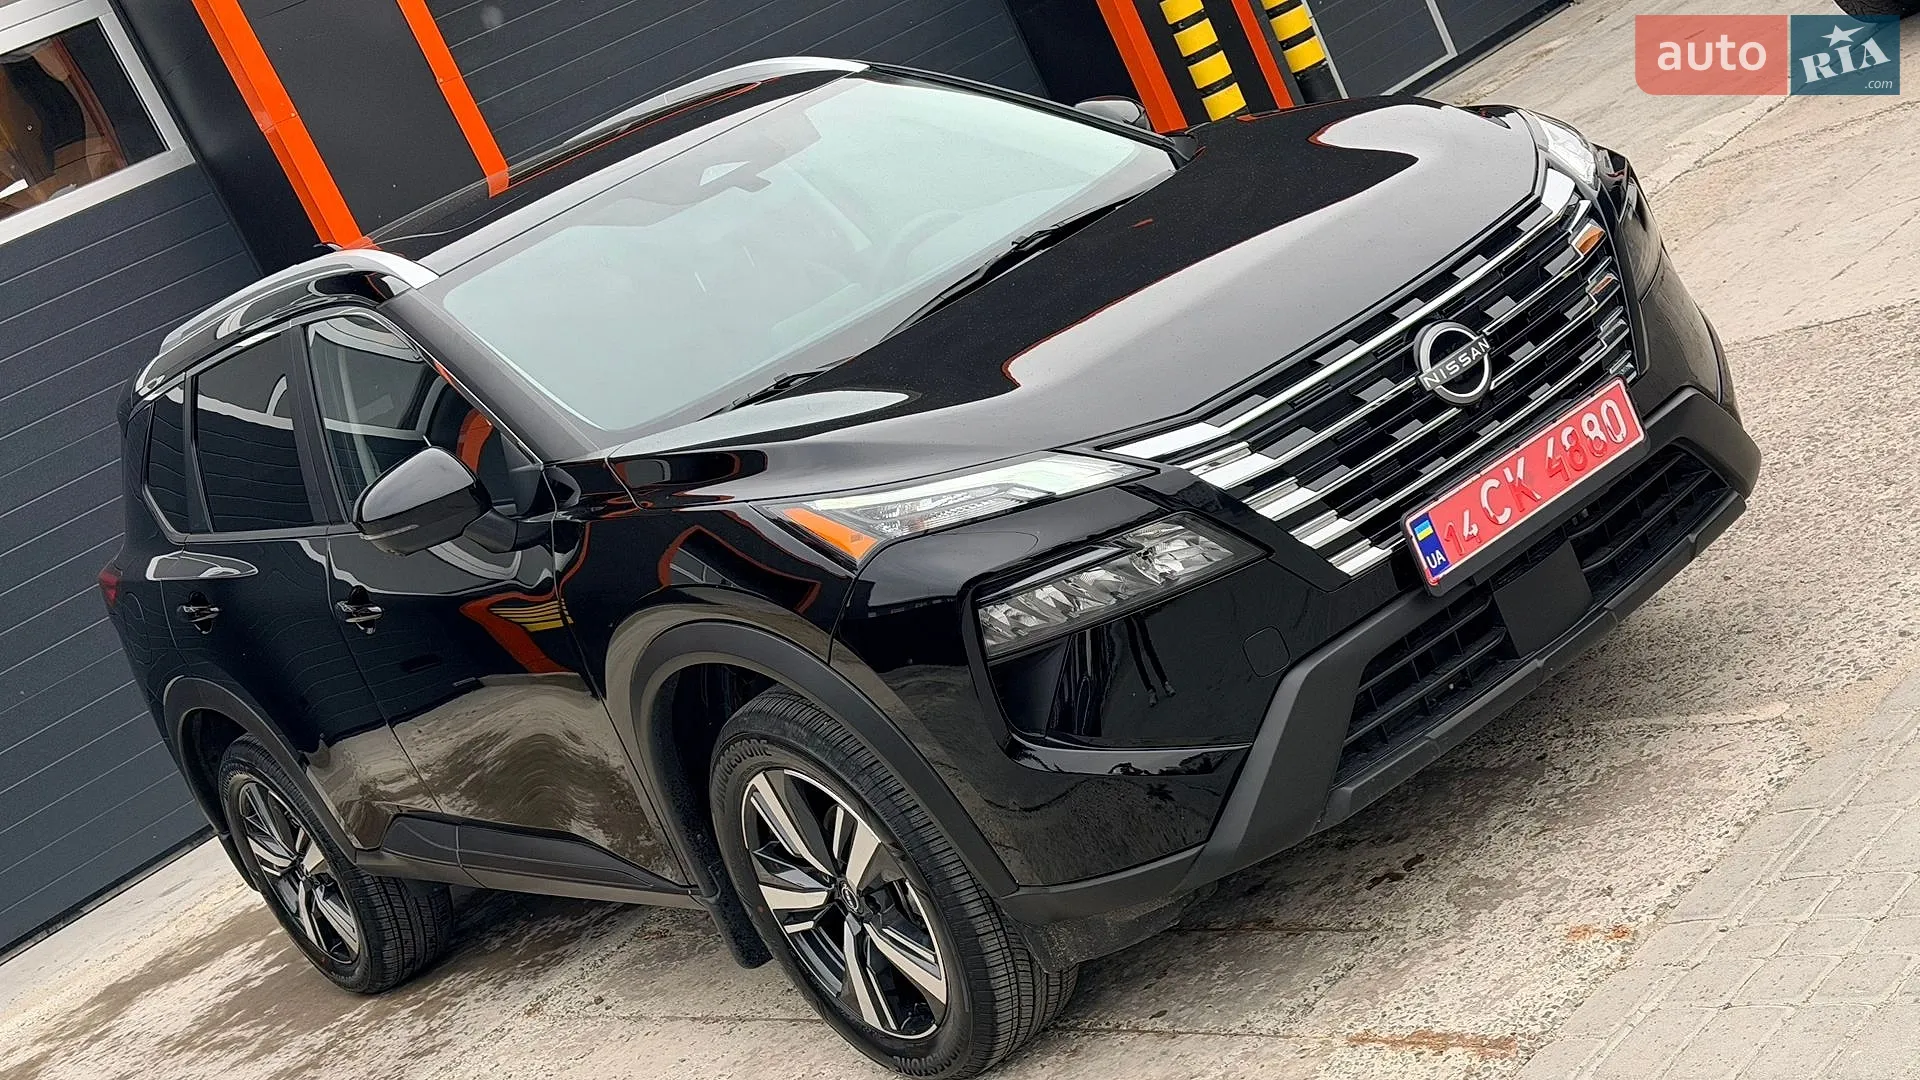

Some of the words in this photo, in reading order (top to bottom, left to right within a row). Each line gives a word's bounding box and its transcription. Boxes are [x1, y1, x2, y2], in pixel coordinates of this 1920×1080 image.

[1423, 338, 1490, 387] NISSAN
[1444, 509, 1482, 556] 14
[1480, 457, 1542, 525] CK
[1545, 399, 1627, 481] 4880
[1427, 551, 1447, 569] UA
